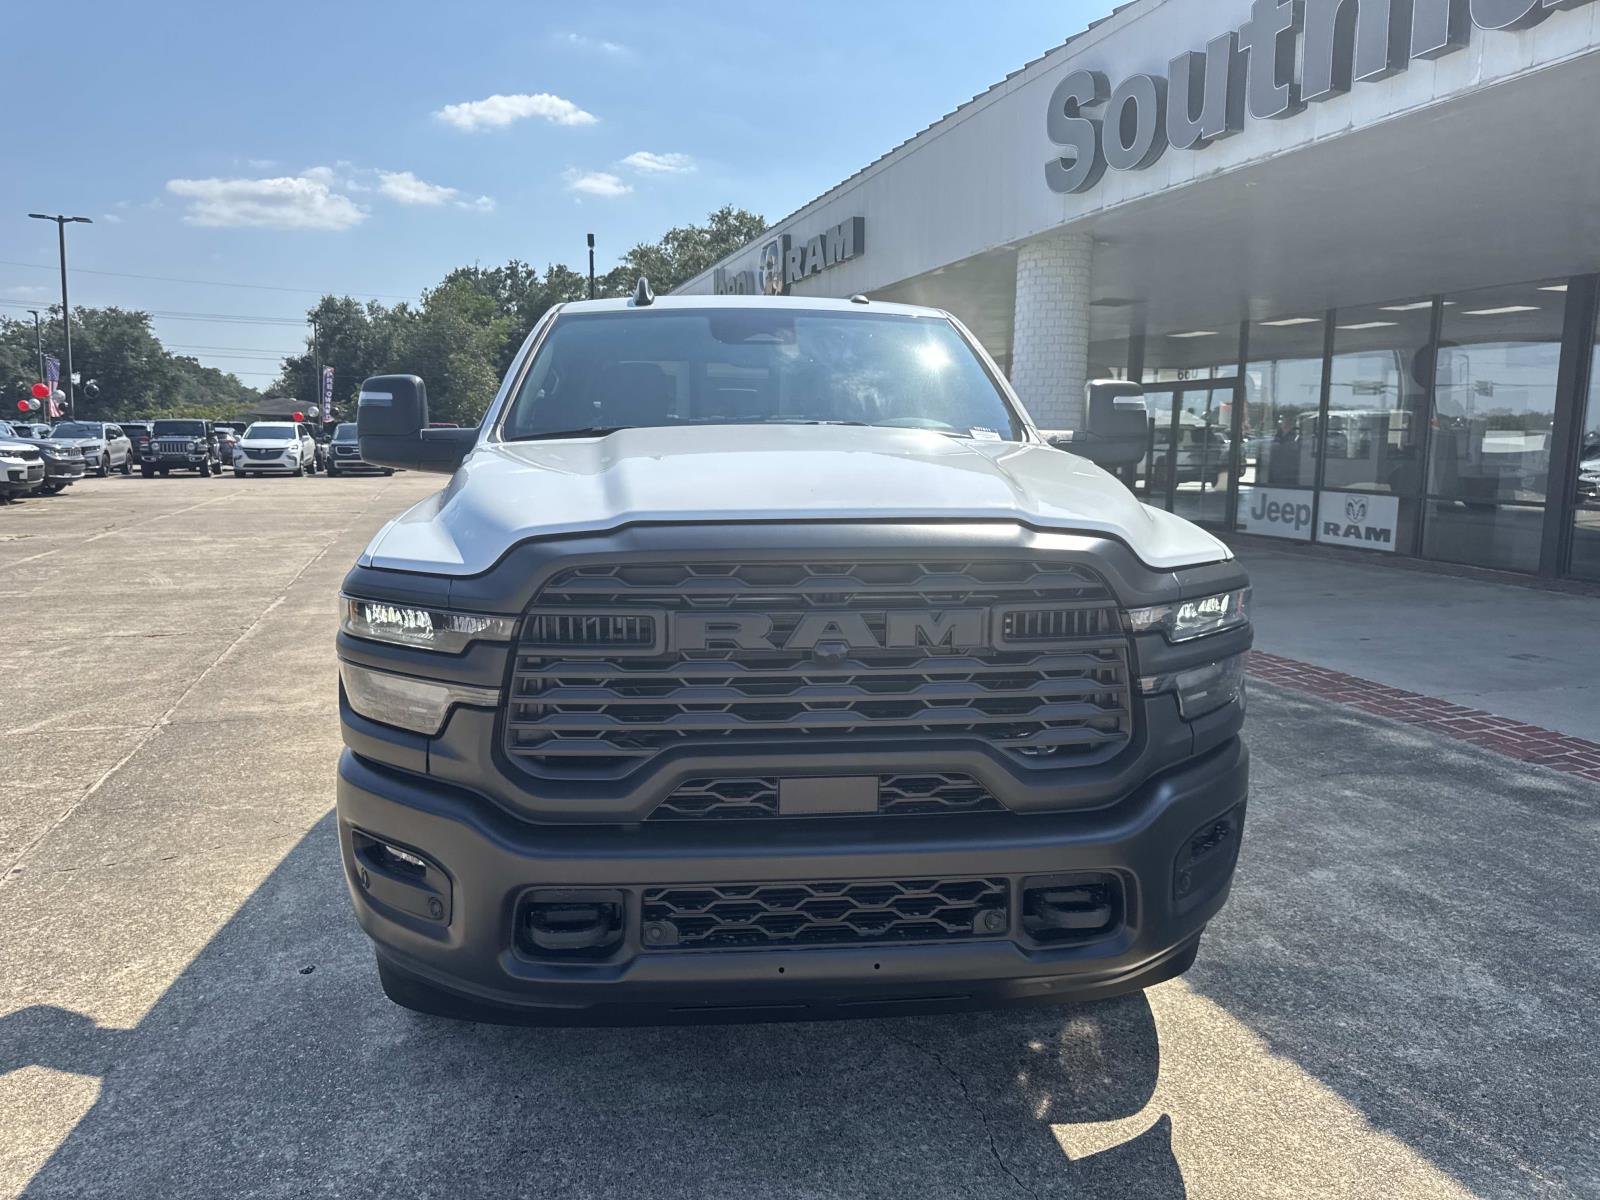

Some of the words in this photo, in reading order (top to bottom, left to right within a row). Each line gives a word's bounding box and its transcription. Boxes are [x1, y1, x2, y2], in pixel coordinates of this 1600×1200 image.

[785, 216, 864, 285] RAM
[1251, 493, 1311, 531] Jeep
[1323, 521, 1391, 543] RAM
[674, 609, 984, 651] RAM
